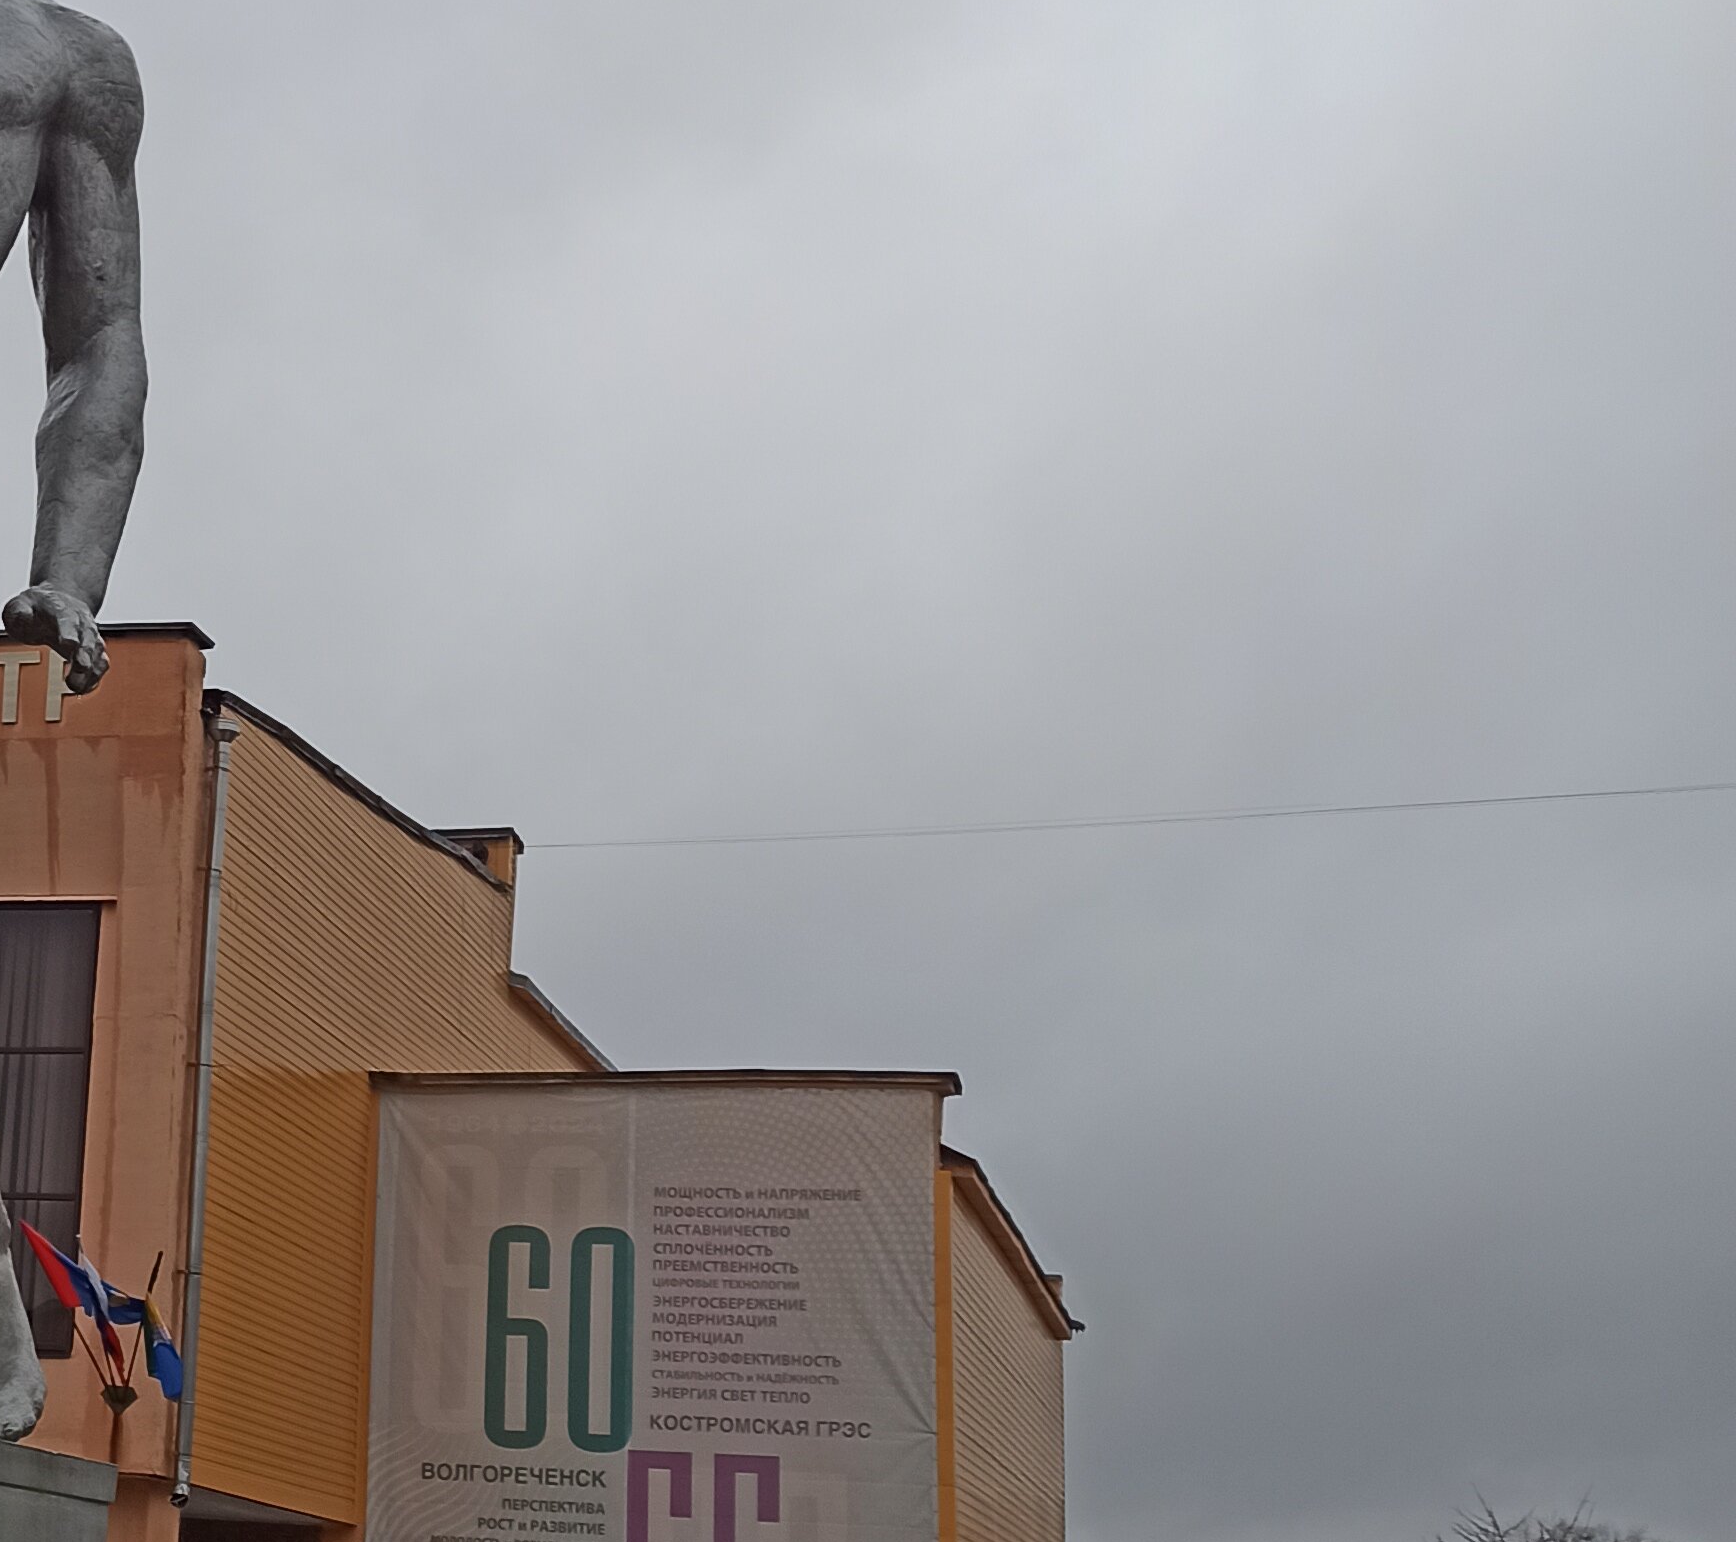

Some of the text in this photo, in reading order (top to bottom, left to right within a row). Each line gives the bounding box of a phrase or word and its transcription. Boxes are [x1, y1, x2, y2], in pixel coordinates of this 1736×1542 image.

[653, 1186, 742, 1201] МОЩНОСТЬ
[757, 1188, 861, 1202] НАПРЯЖЕНИЕ
[653, 1205, 810, 1220] ПРОФЕССИОНАЛИЗМ
[653, 1223, 791, 1238] НАСТАВНИЧЕСТВО
[652, 1259, 799, 1274] ПРЕЕМСТВЕННОСТЬ
[652, 1295, 807, 1311] ЭНЕРГОСБЕРЕЖЕНИЕ
[652, 1312, 778, 1328] МОДЕРНИЗАЦИЯ
[484, 1225, 635, 1453] 60
[652, 1330, 744, 1346] ПОТЕНЦИАЛ
[652, 1350, 842, 1367] ЭНЕРГОЭФФЕКТИВНОСТЬ
[652, 1370, 744, 1382] СТАБИЛЬНОСТЬ
[651, 1386, 811, 1404] ЭНЕРГИЯ СВЕТ ТЕПЛО
[649, 1415, 872, 1439] КОСТРОМСКАЯ ГРЭС
[421, 1462, 607, 1488] ВОЛГОРЕЧЕНСК
[502, 1498, 605, 1515] ПЕРСПЕКТИВА
[477, 1517, 514, 1531] РОСТ
[530, 1519, 605, 1535] РАЗВИТИЕ
